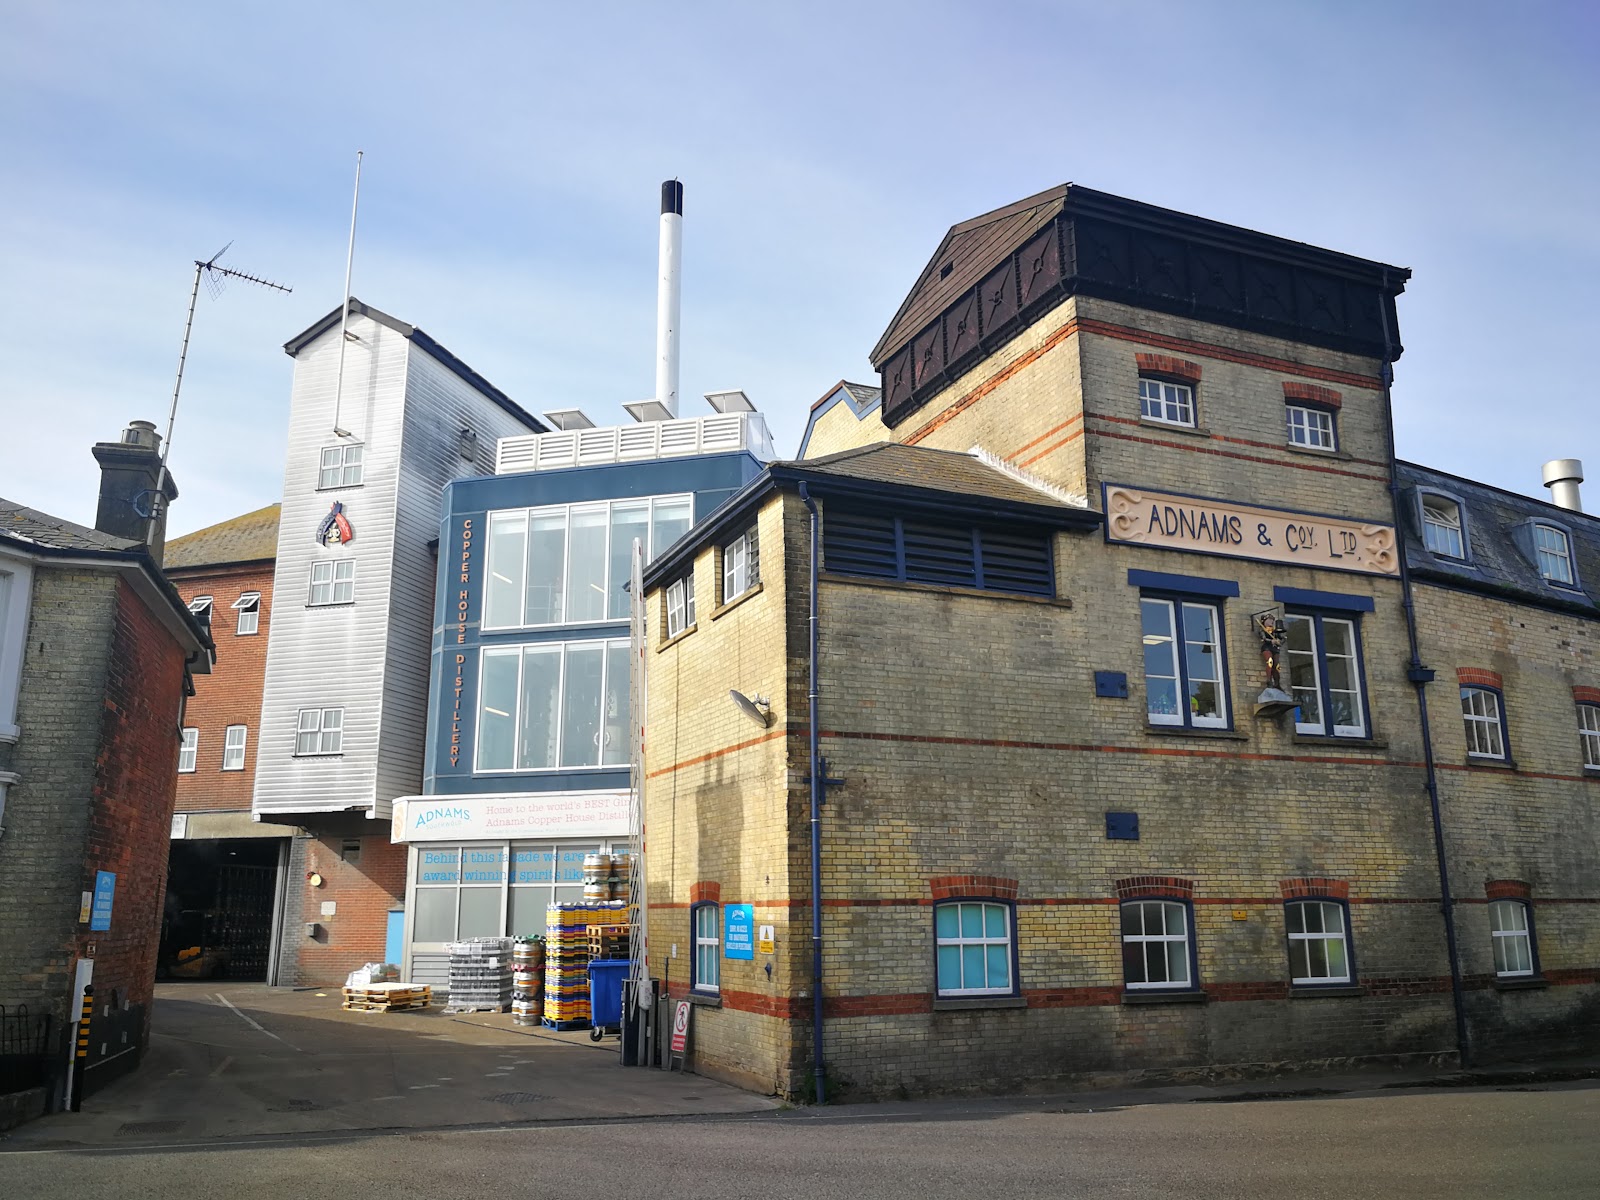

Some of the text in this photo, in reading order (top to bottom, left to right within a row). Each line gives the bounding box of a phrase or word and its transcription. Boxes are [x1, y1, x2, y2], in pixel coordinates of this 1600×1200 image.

[1147, 504, 1242, 545] ADNAMS
[1257, 523, 1273, 546] &
[450, 520, 472, 768] COPPER HOUSE DISTILLERY
[486, 805, 513, 815] Home
[516, 805, 525, 813] to
[528, 803, 544, 813] the
[546, 801, 581, 812] world's
[584, 799, 611, 809] BEST
[415, 807, 471, 829] ADNAMS
[486, 817, 525, 827] Adnams
[527, 815, 562, 826] Copper
[565, 813, 595, 823] House
[424, 852, 467, 864] Behind
[471, 851, 495, 863] this
[543, 853, 560, 862] we
[564, 852, 584, 861] are
[423, 870, 461, 881] award
[464, 869, 516, 883] winning
[519, 869, 560, 882] spirits
